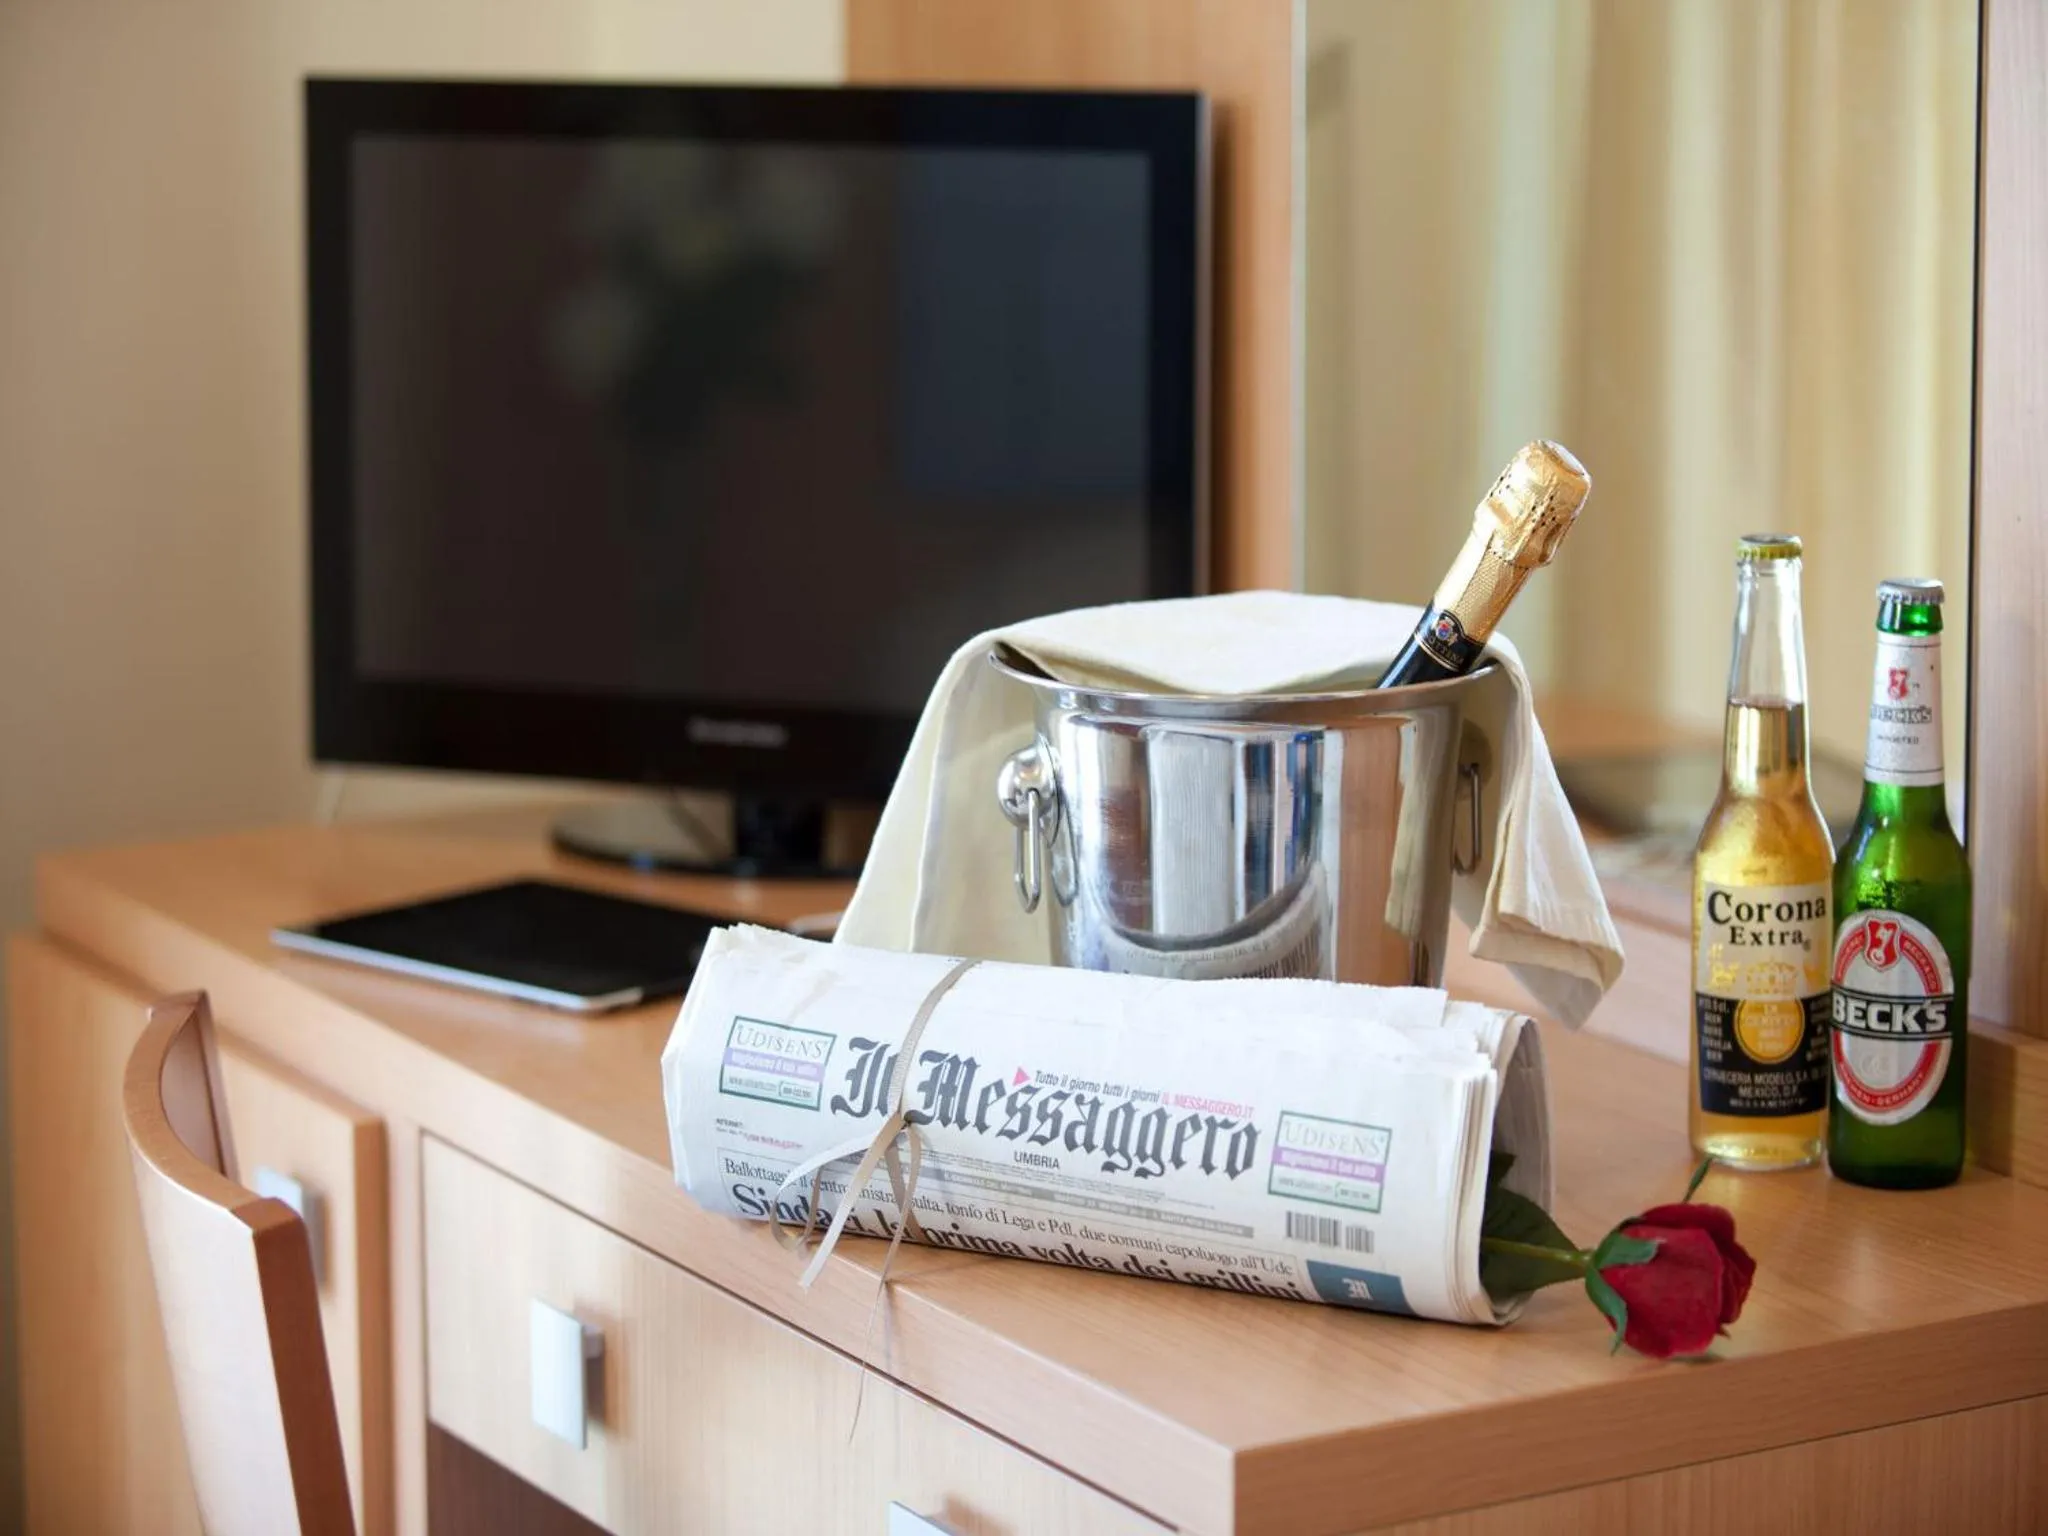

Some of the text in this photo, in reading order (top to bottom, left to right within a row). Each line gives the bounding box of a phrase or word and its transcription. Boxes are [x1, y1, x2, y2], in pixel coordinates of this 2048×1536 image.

[1708, 889, 1826, 925] Corona
[1729, 925, 1803, 946] Extra
[1832, 993, 1947, 1034] BECK'S
[1035, 1070, 1059, 1087] Tutto
[1060, 1075, 1069, 1088] il
[1069, 1078, 1101, 1094] giorno
[1102, 1082, 1124, 1098] tutti
[1130, 1088, 1161, 1105] giorni
[1172, 1094, 1255, 1118] MESSAGGERO.IT
[903, 1050, 1262, 1180] Messaggero
[1013, 1150, 1061, 1169] UMBRIA
[945, 1201, 982, 1219] tonfo
[985, 1207, 999, 1223] di
[1001, 1209, 1035, 1231] Lega
[1037, 1221, 1046, 1232] e
[1079, 1225, 1106, 1243] due
[1108, 1233, 1162, 1253] comuni
[1028, 1242, 1115, 1270] volta
[1122, 1253, 1180, 1281] dei
